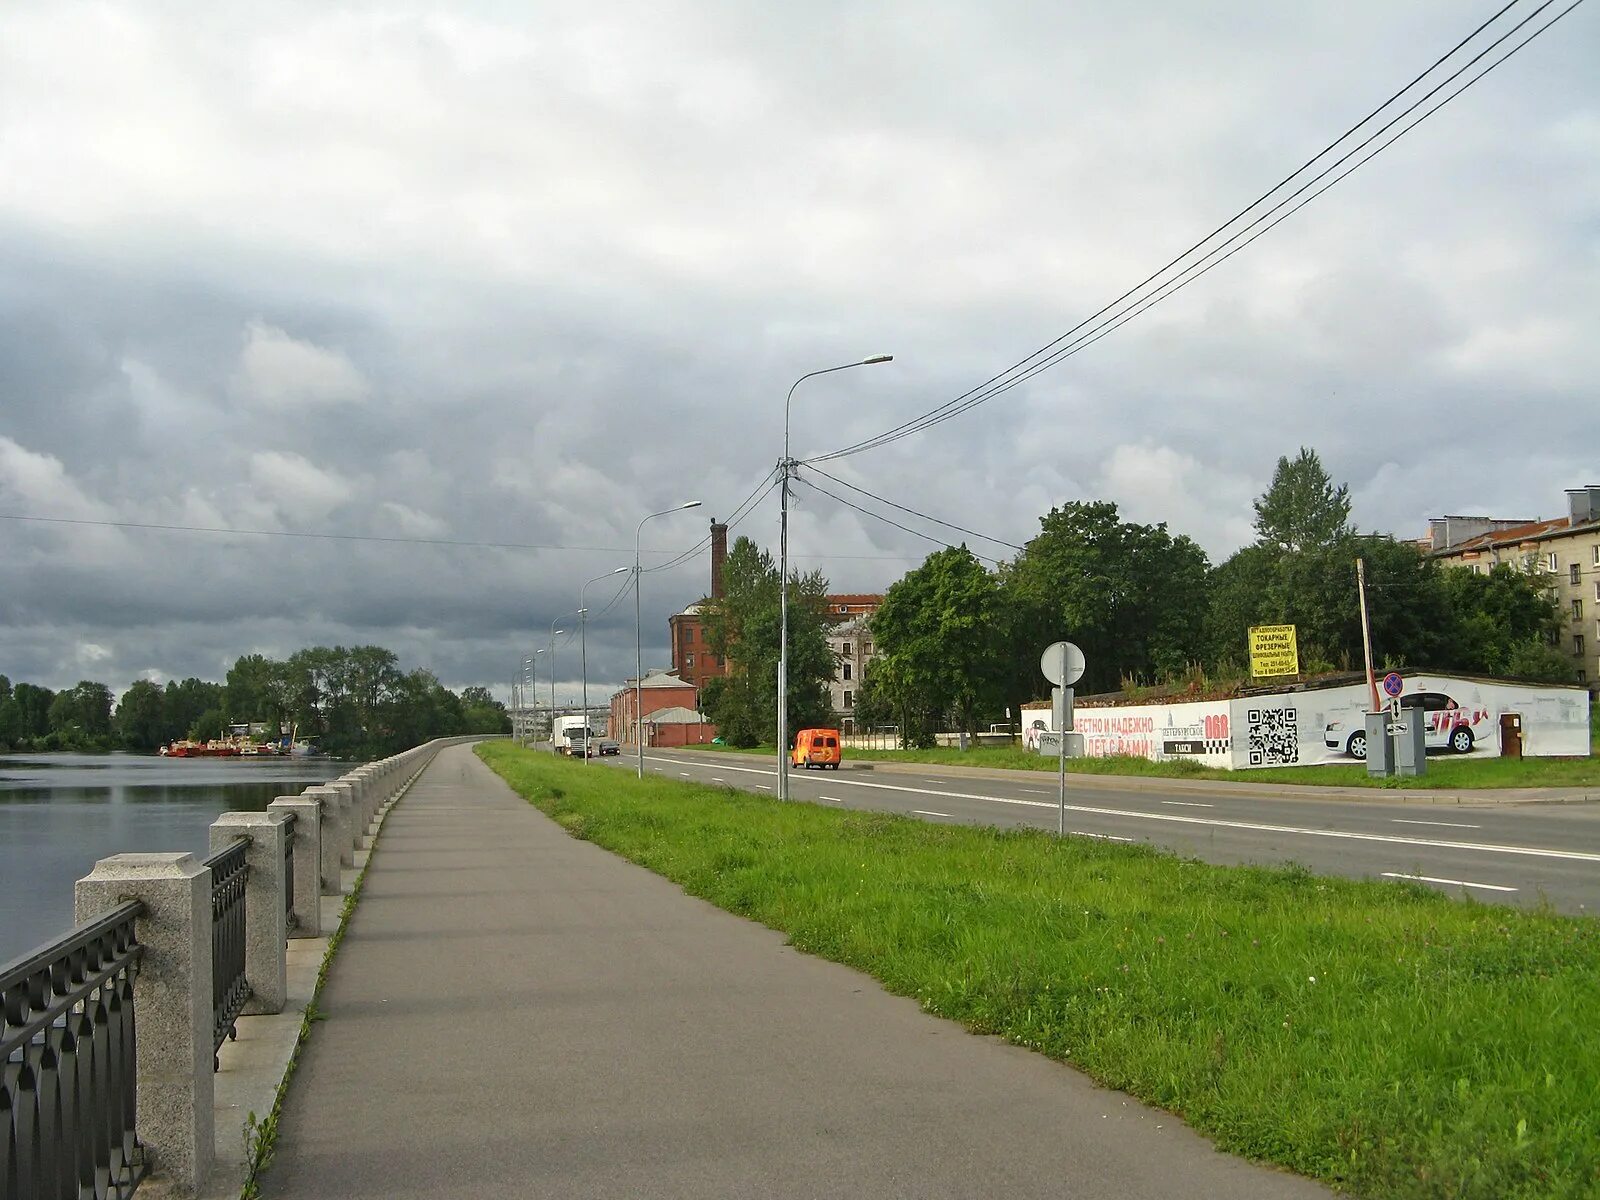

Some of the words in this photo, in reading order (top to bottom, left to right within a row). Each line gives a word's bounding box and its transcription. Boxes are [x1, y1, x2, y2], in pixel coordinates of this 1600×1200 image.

[1257, 634, 1287, 642] ТОКАРНЫЕ
[1074, 718, 1103, 733] ЧЕСТНО
[1104, 718, 1109, 733] И
[1112, 717, 1153, 734] НАДЕЖНО
[1205, 714, 1229, 739] 068
[1174, 744, 1192, 753] ТАКСИ
